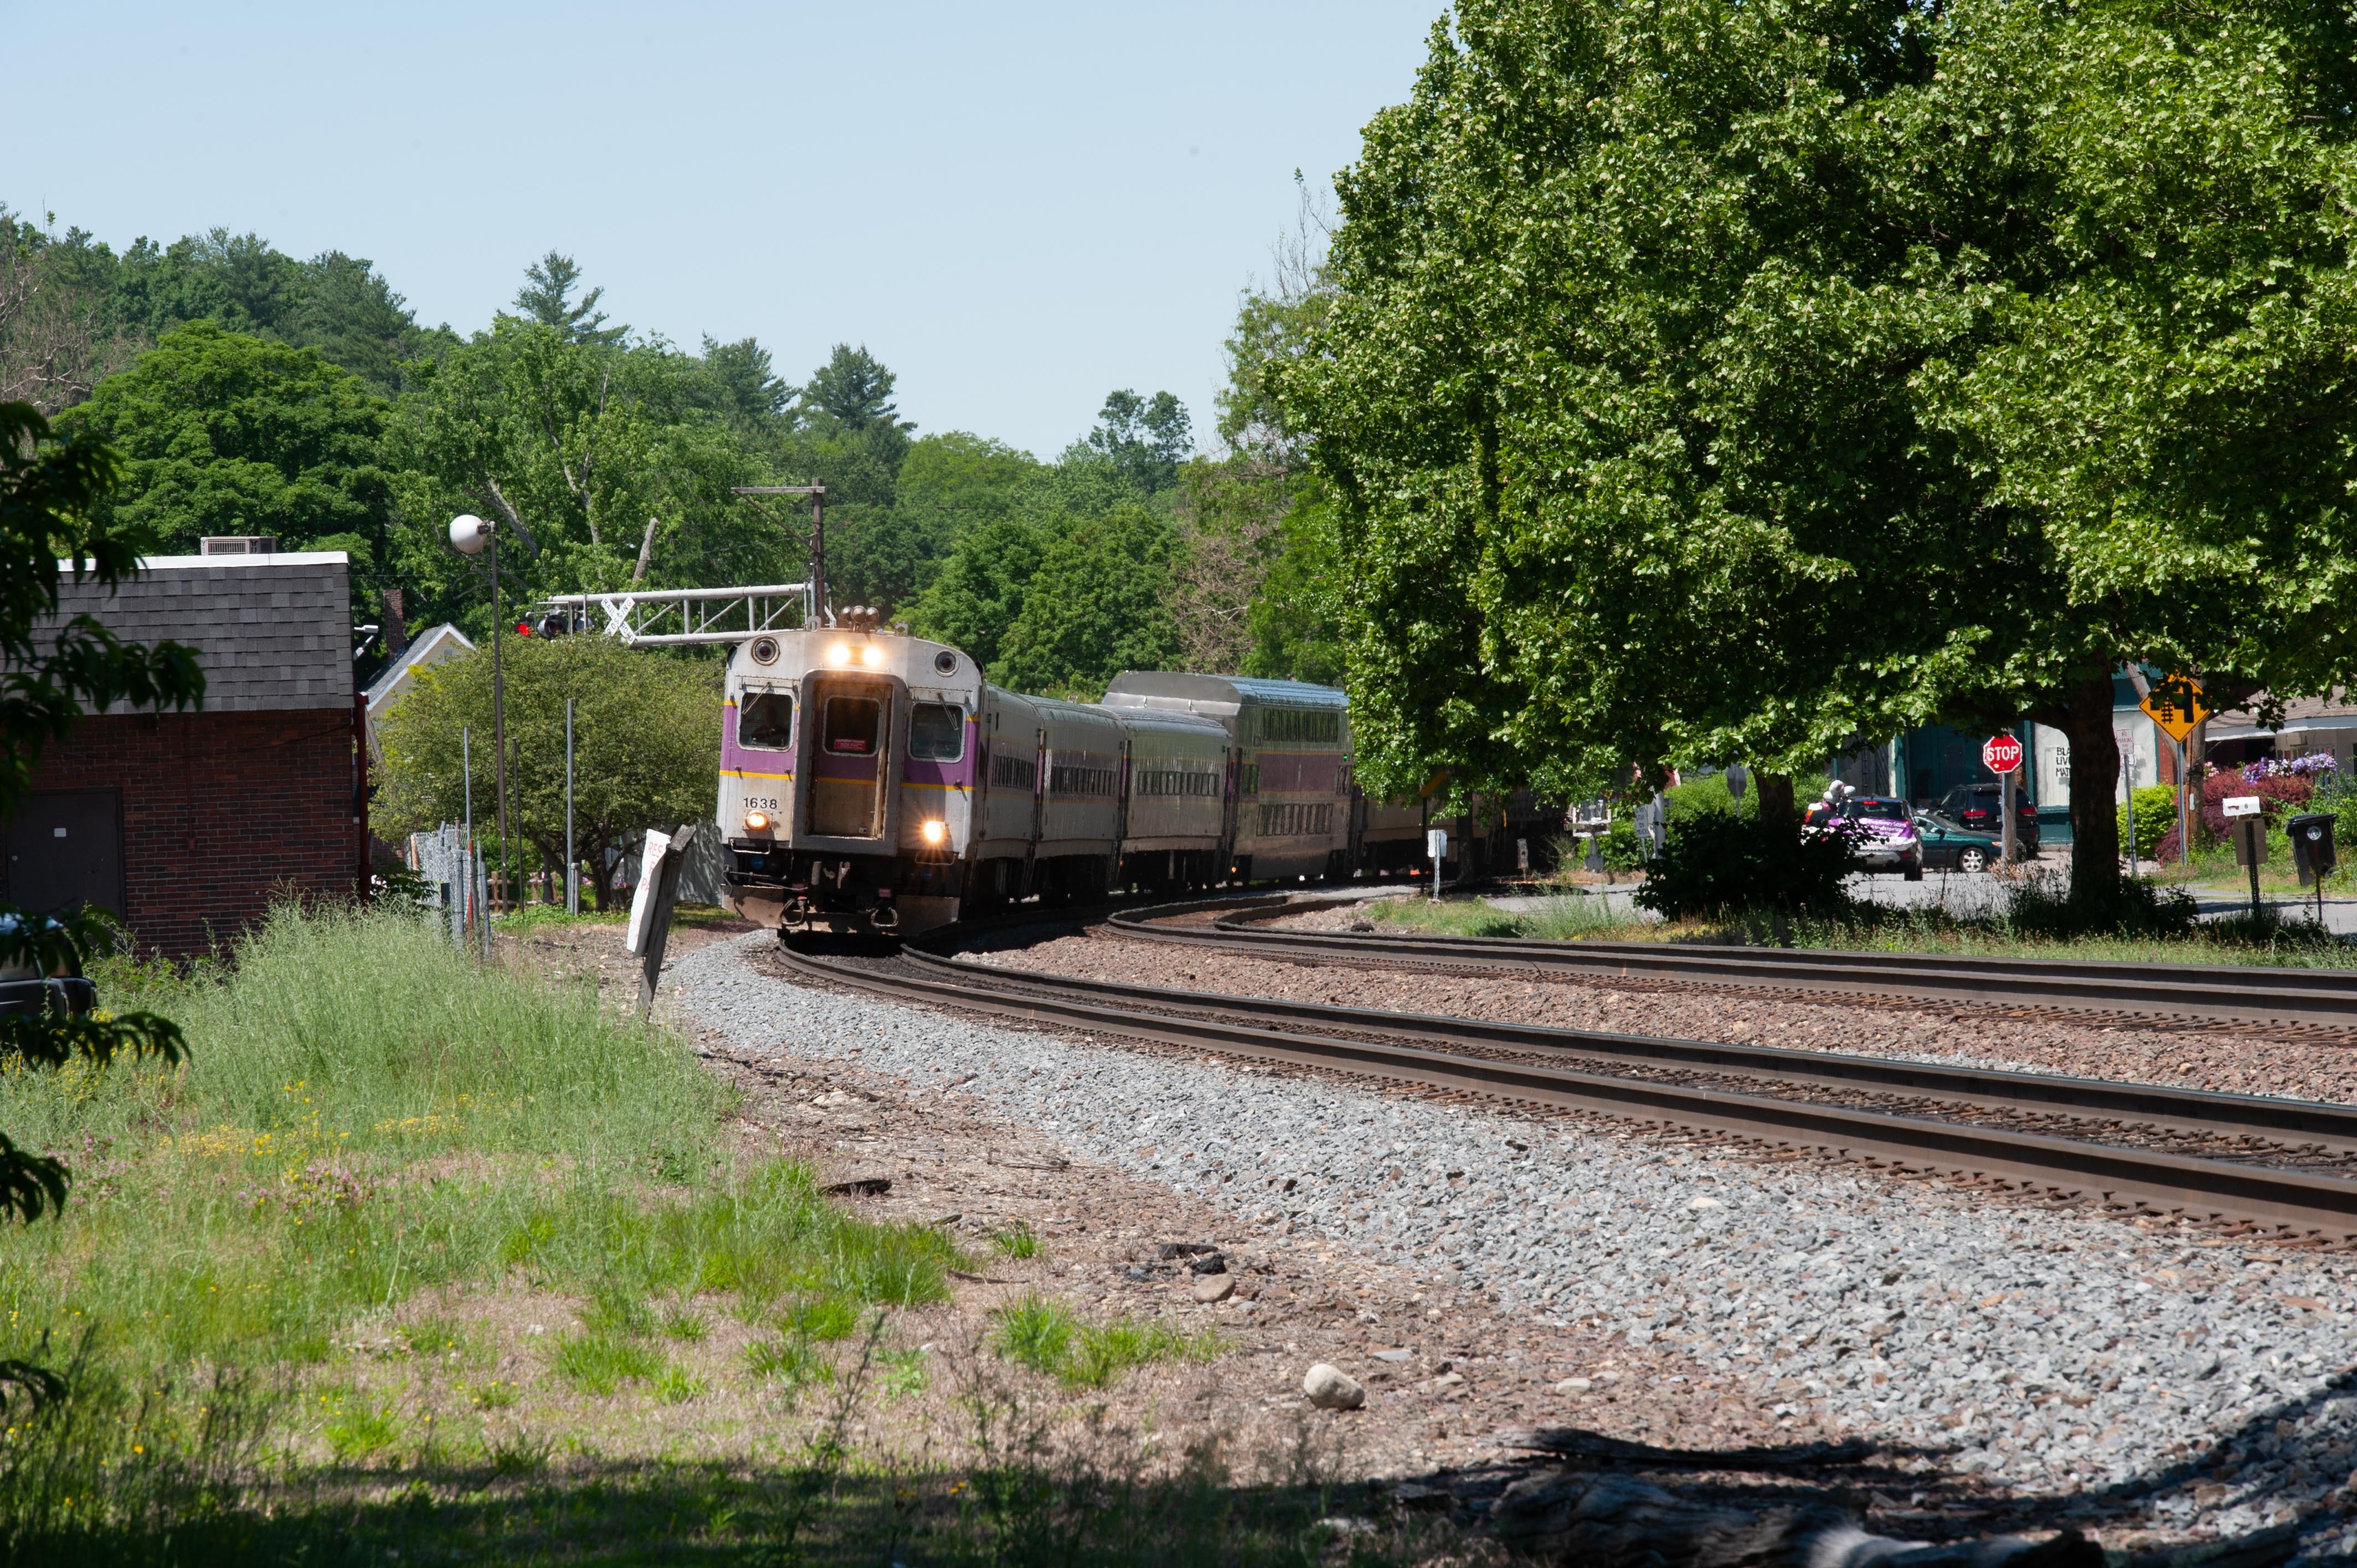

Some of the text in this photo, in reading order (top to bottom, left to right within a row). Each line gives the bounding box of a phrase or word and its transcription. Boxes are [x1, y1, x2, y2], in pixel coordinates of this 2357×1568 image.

[604, 599, 615, 617] RAIL
[606, 599, 632, 637] ROSSING
[1987, 746, 2019, 761] STOP
[743, 797, 777, 809] 1638
